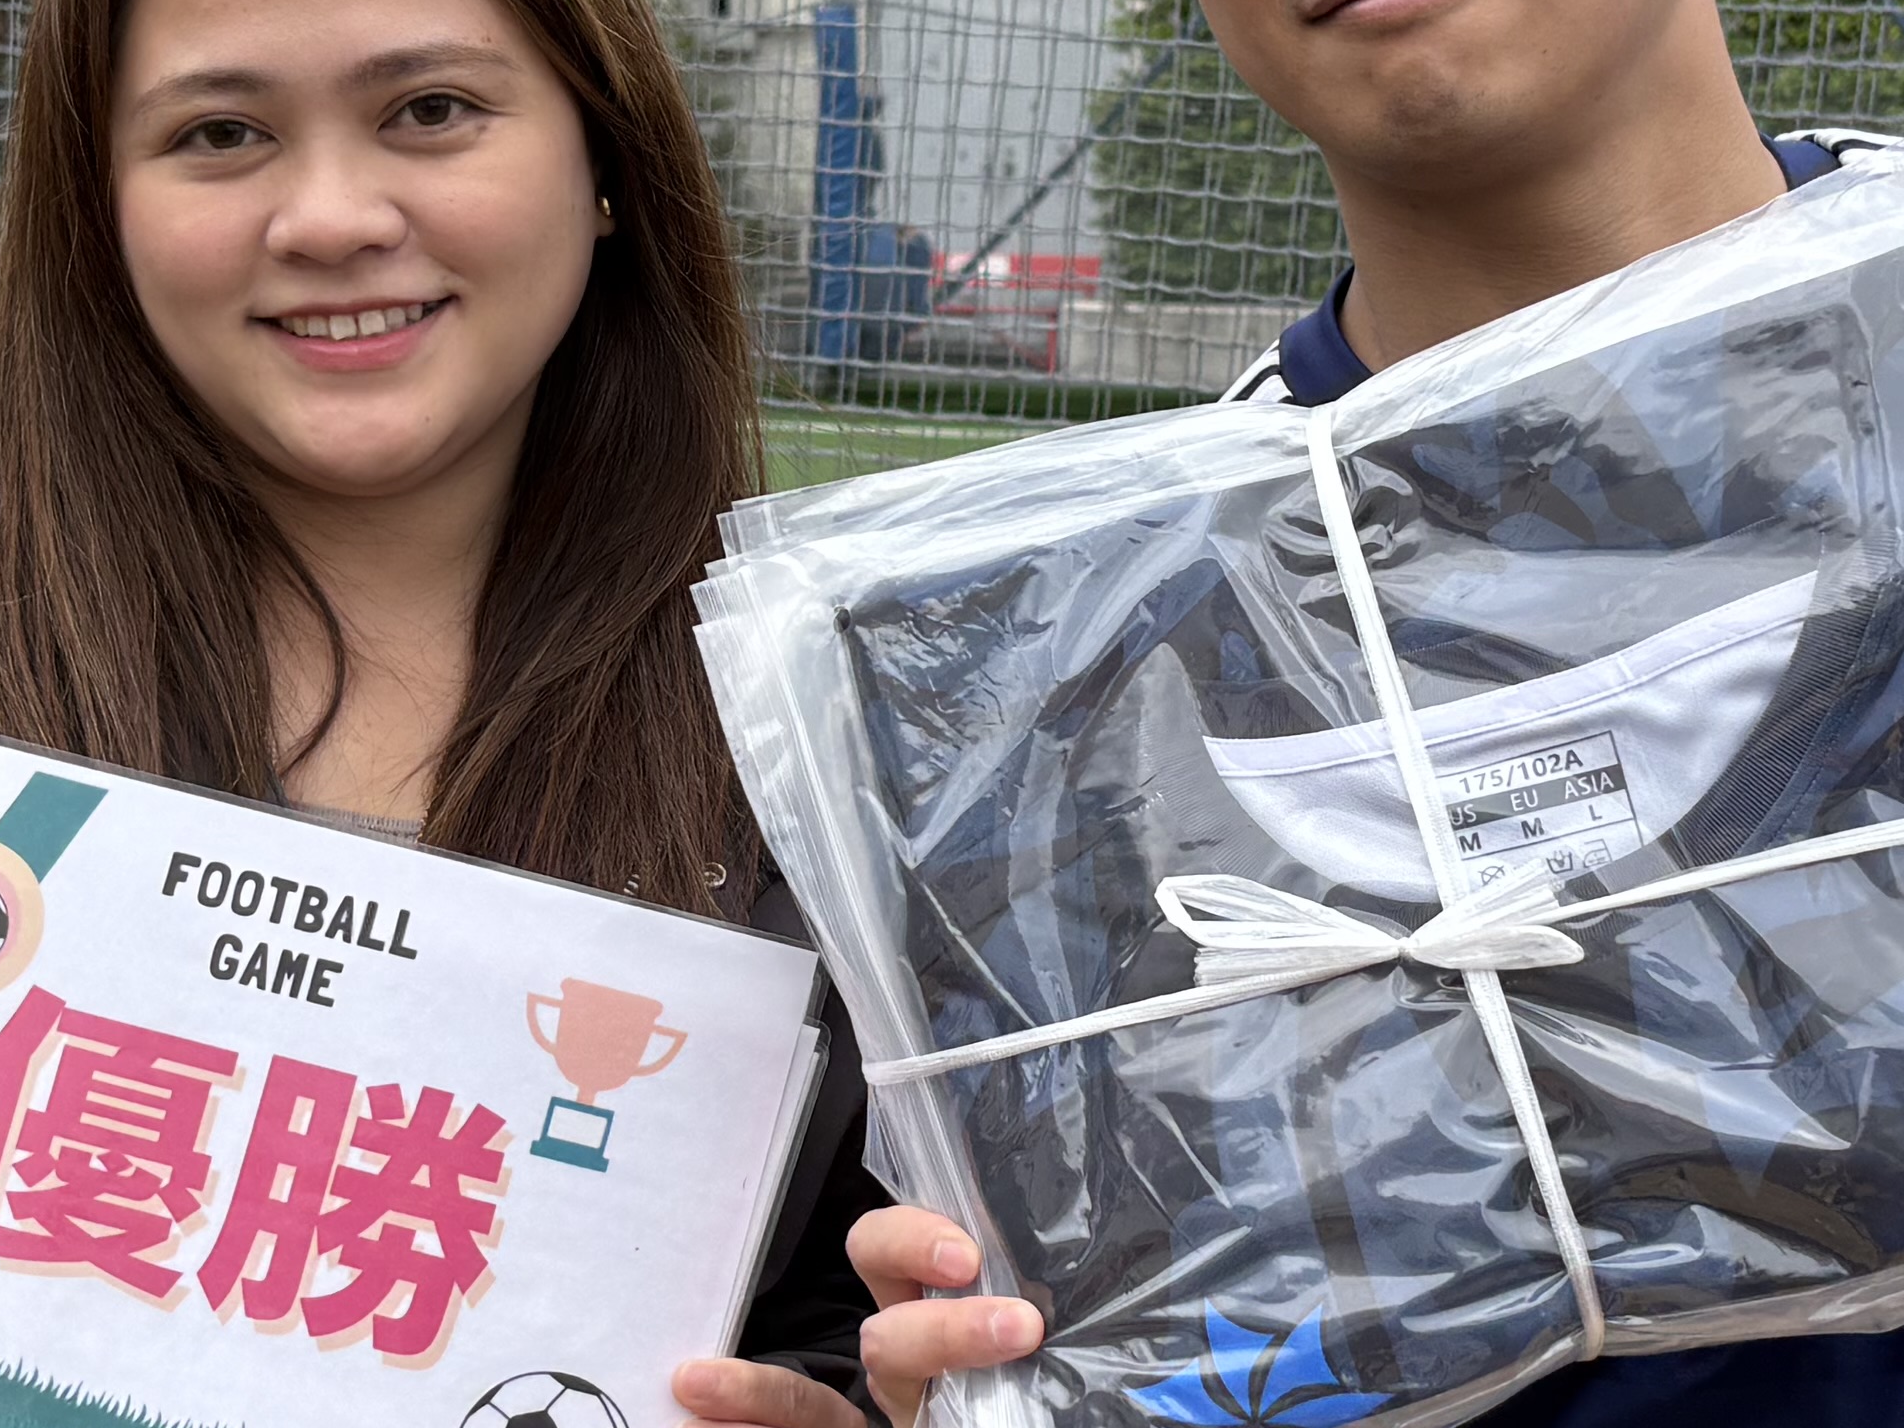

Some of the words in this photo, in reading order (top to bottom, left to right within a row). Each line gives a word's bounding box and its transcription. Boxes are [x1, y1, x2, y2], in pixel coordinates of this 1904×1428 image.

[1449, 803, 1477, 827] US
[1510, 790, 1539, 812] EU
[1564, 771, 1615, 800] ASIA
[1459, 749, 1584, 794] 175/102A
[1459, 832, 1482, 853] M
[1520, 817, 1545, 839] M
[1587, 804, 1603, 821] L
[161, 850, 419, 960] FOOTBALL
[207, 933, 345, 1008] GAME
